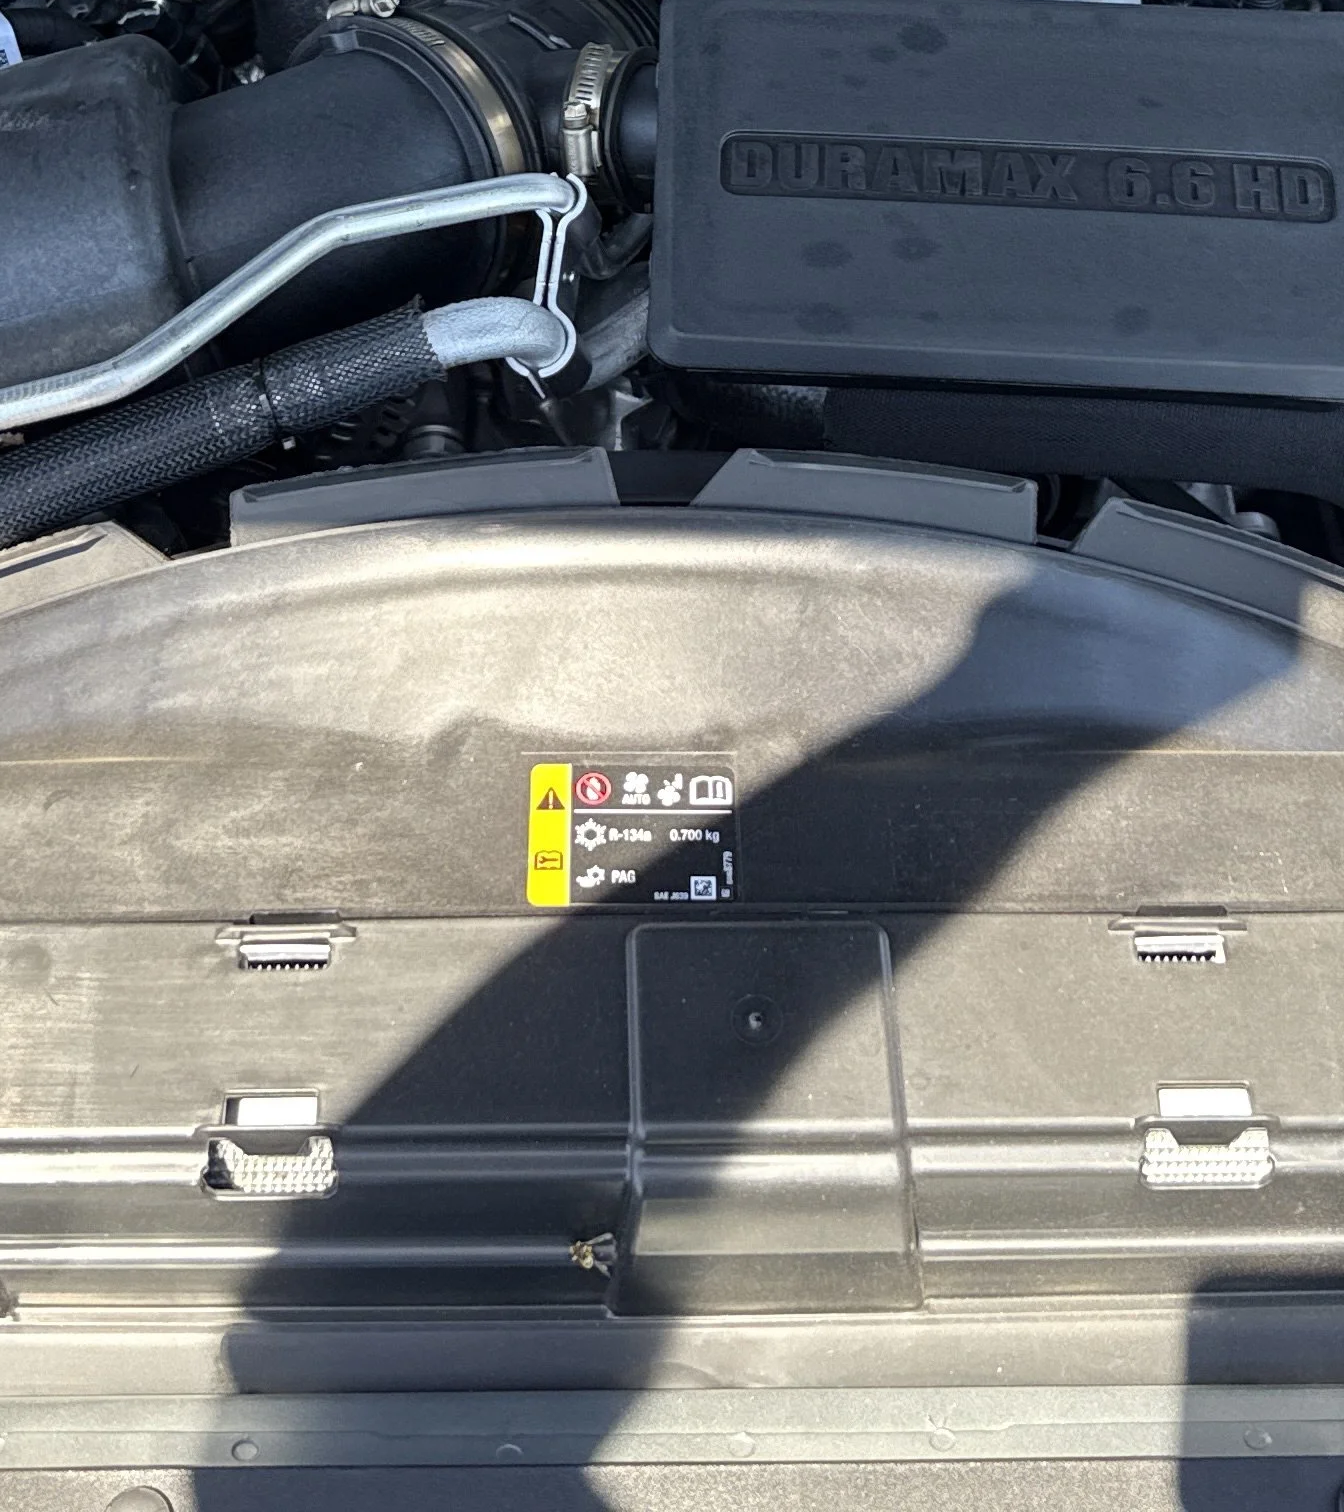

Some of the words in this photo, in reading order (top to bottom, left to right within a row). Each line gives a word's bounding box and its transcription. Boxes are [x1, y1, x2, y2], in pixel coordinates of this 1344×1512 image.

[730, 140, 1078, 203] DURAMAX
[1107, 157, 1216, 211] 6.6
[1233, 162, 1327, 216] HD
[621, 793, 652, 806] AUTO
[608, 828, 652, 842] R-134a
[669, 828, 703, 842] 0.700
[705, 829, 721, 844] kg
[611, 869, 637, 884] PAG
